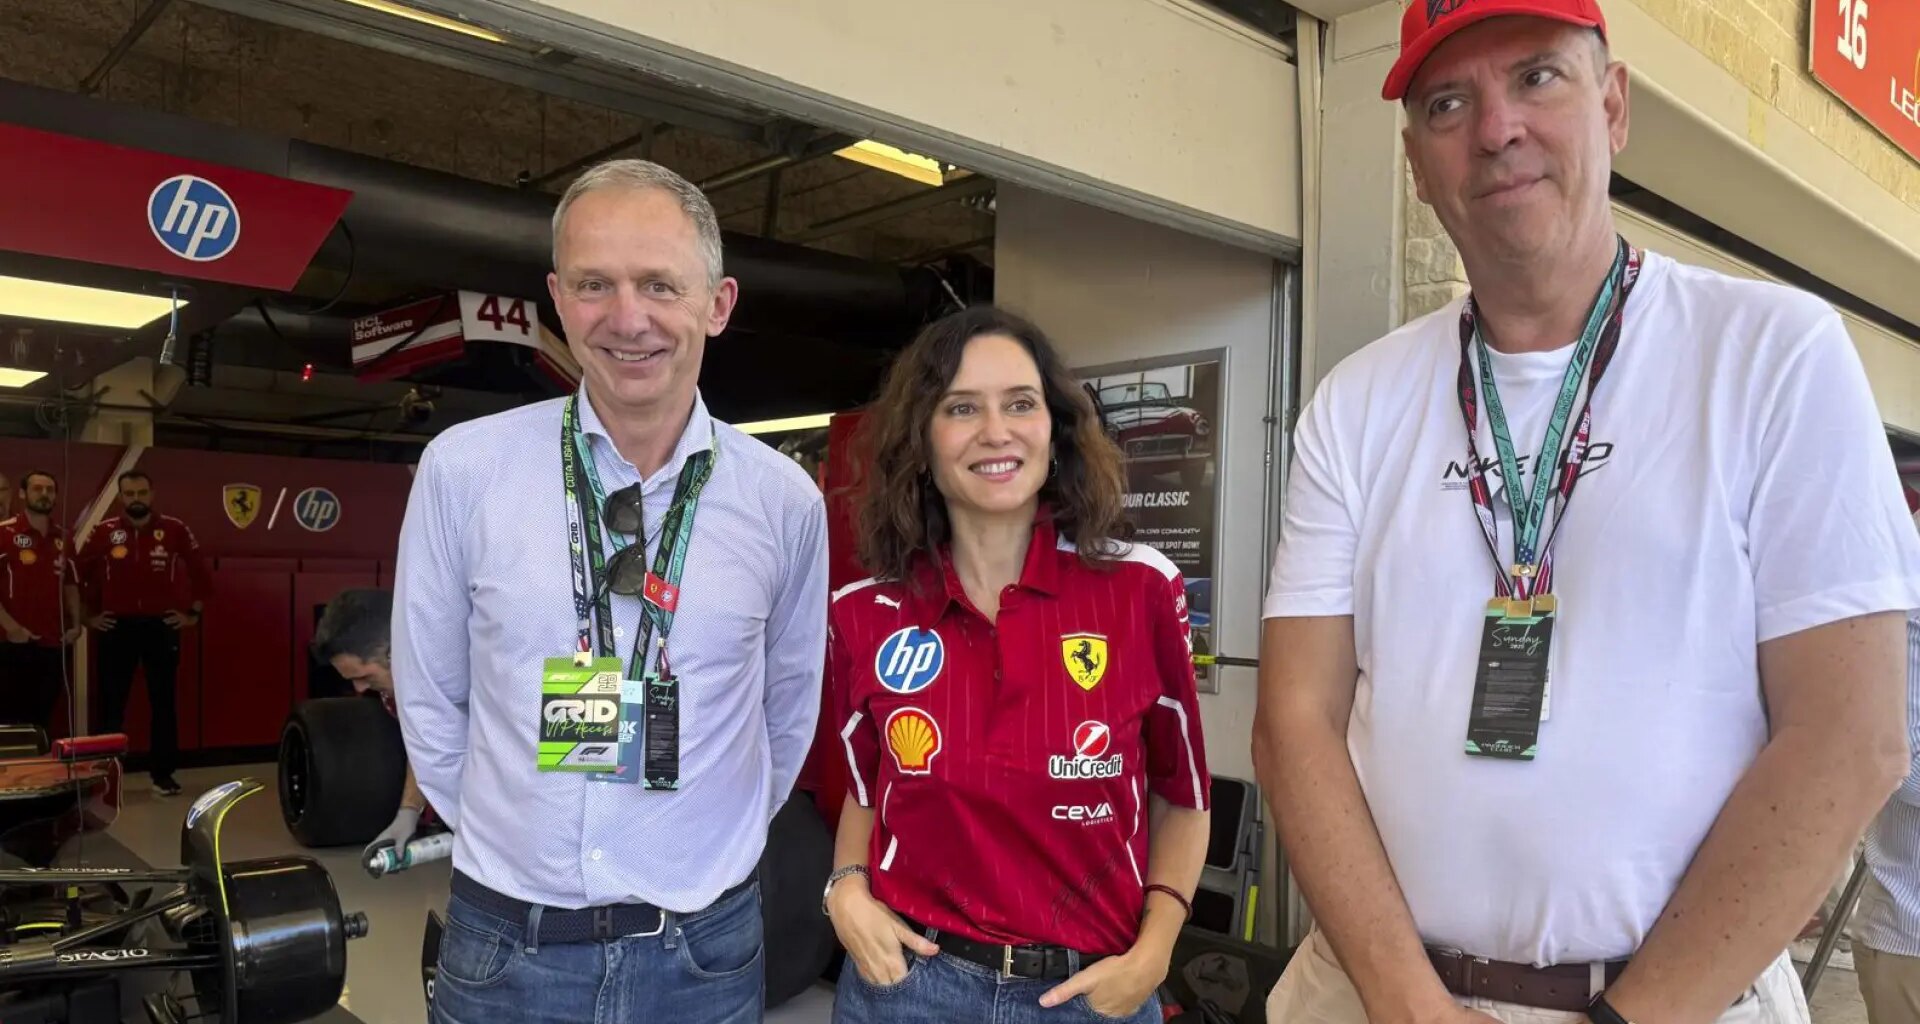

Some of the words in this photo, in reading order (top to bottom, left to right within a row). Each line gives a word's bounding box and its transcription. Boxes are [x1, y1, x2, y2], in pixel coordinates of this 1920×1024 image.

[1837, 0, 1868, 70] 16
[160, 177, 230, 259] hp
[354, 315, 384, 330] HCL
[476, 295, 531, 336] 44
[355, 318, 414, 341] Software
[302, 490, 335, 529] hp
[1121, 492, 1144, 509] OUR
[1144, 491, 1190, 507] CLASSIC
[570, 521, 579, 544] GRID
[1161, 527, 1201, 536] COMMUNITY
[1165, 541, 1182, 549] SPOT
[1491, 624, 1543, 656] Sunday
[884, 629, 937, 691] hp
[543, 699, 618, 723] GRID
[1050, 754, 1122, 777] UniCredit
